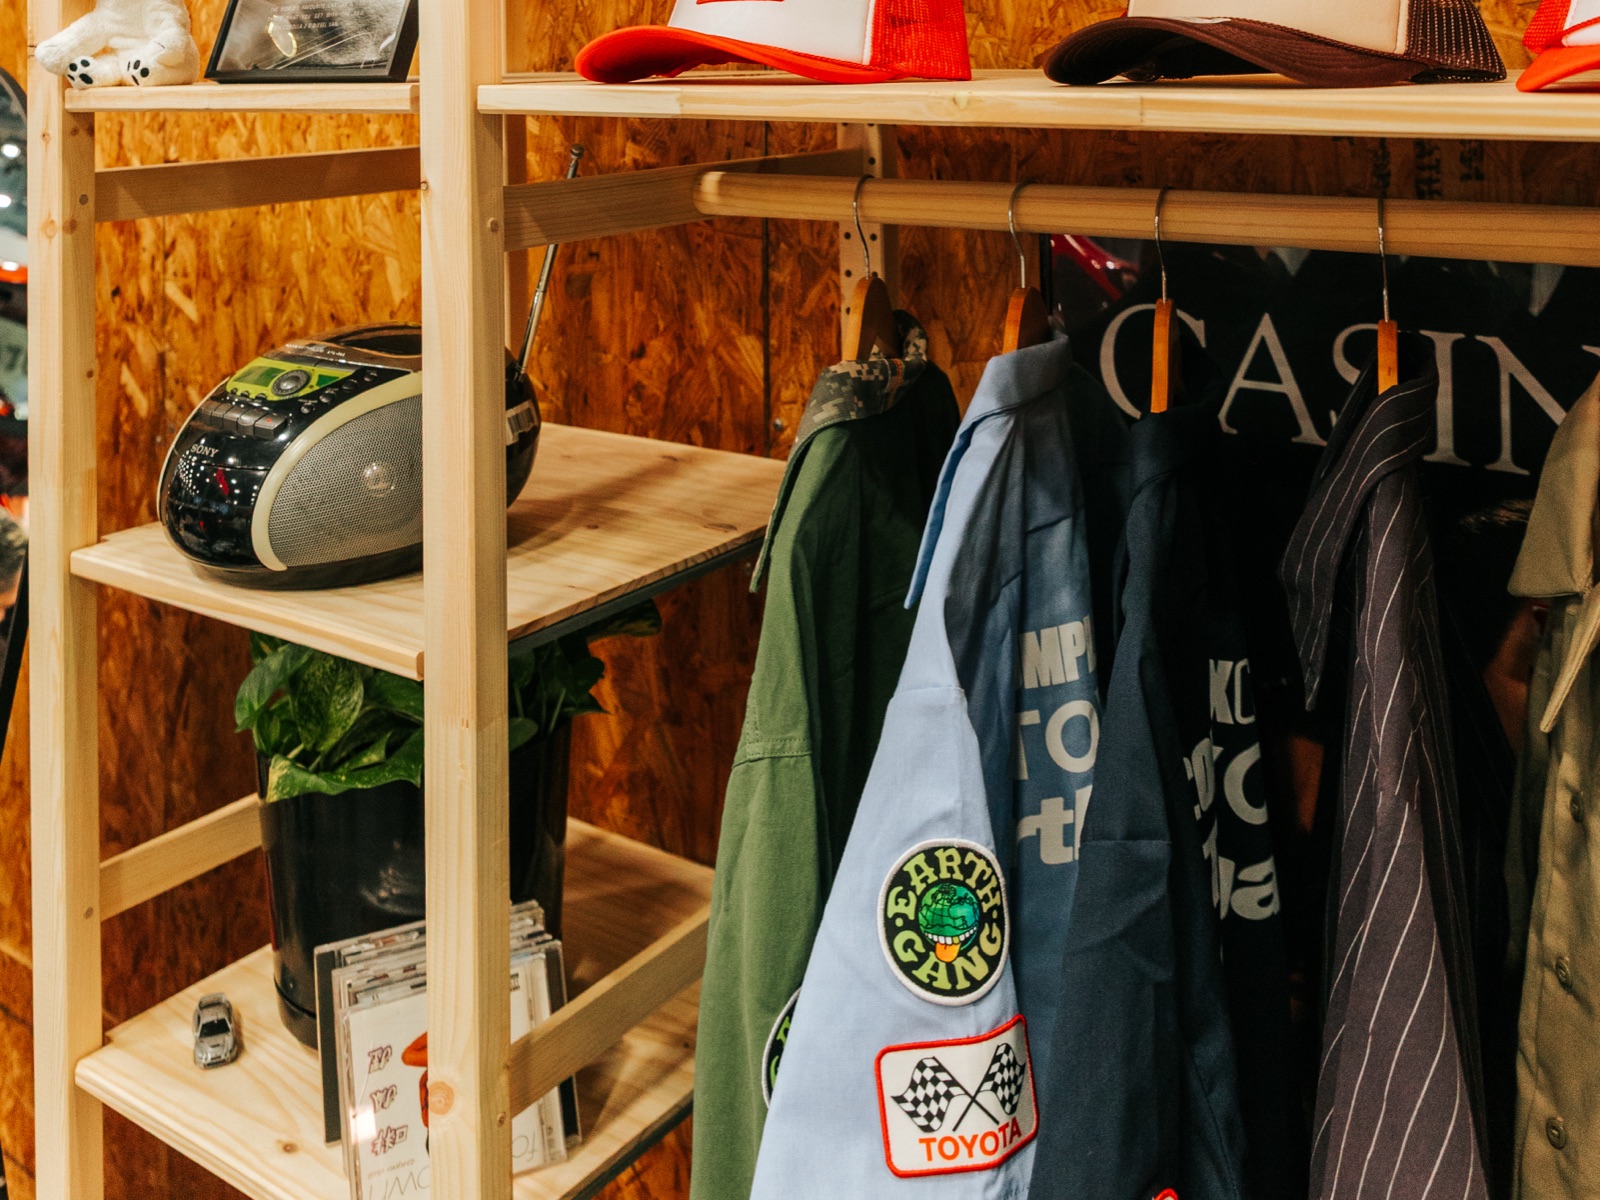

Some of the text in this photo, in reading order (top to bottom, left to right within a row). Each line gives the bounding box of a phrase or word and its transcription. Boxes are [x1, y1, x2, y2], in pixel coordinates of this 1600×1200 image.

[190, 443, 219, 458] SONY
[887, 848, 1001, 921] EARTH
[893, 922, 1002, 990] GANG
[918, 1116, 1021, 1163] TOYOTA
